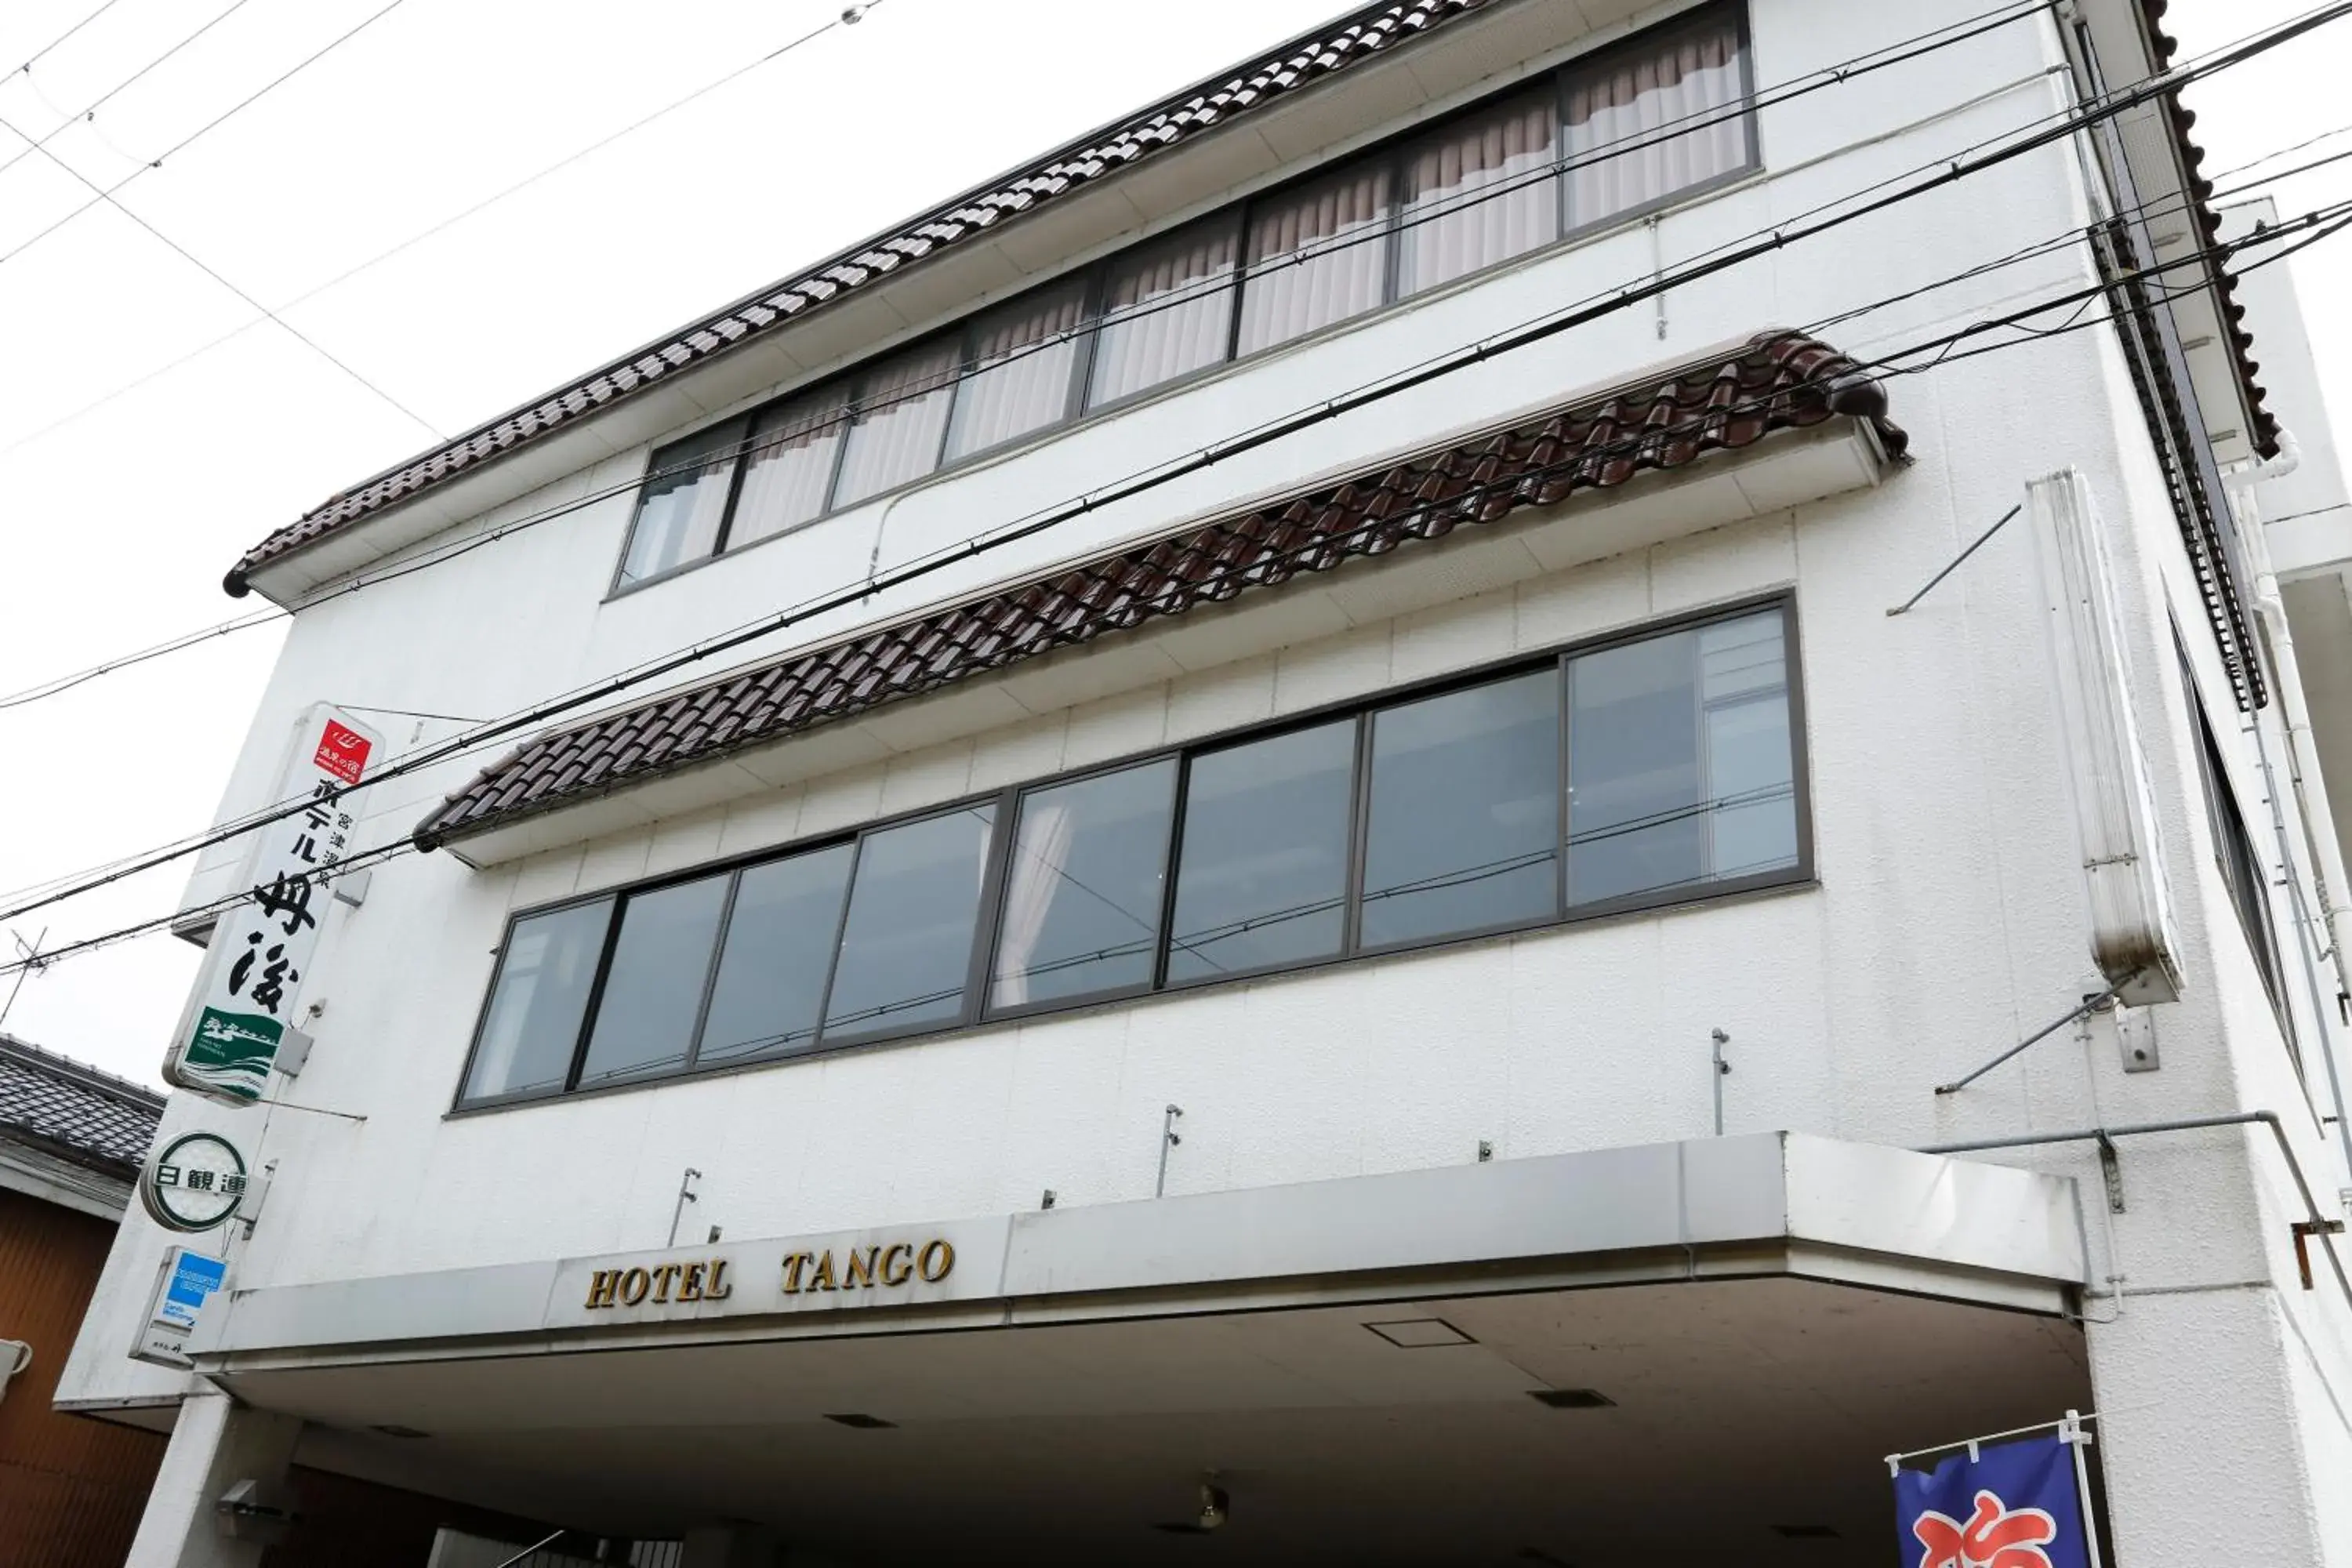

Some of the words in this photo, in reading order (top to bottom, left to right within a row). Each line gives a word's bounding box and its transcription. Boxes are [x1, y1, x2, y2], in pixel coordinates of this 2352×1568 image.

[155, 1163, 247, 1197] 日観連
[584, 1258, 732, 1310] HOTEL
[781, 1238, 956, 1295] TANGO
